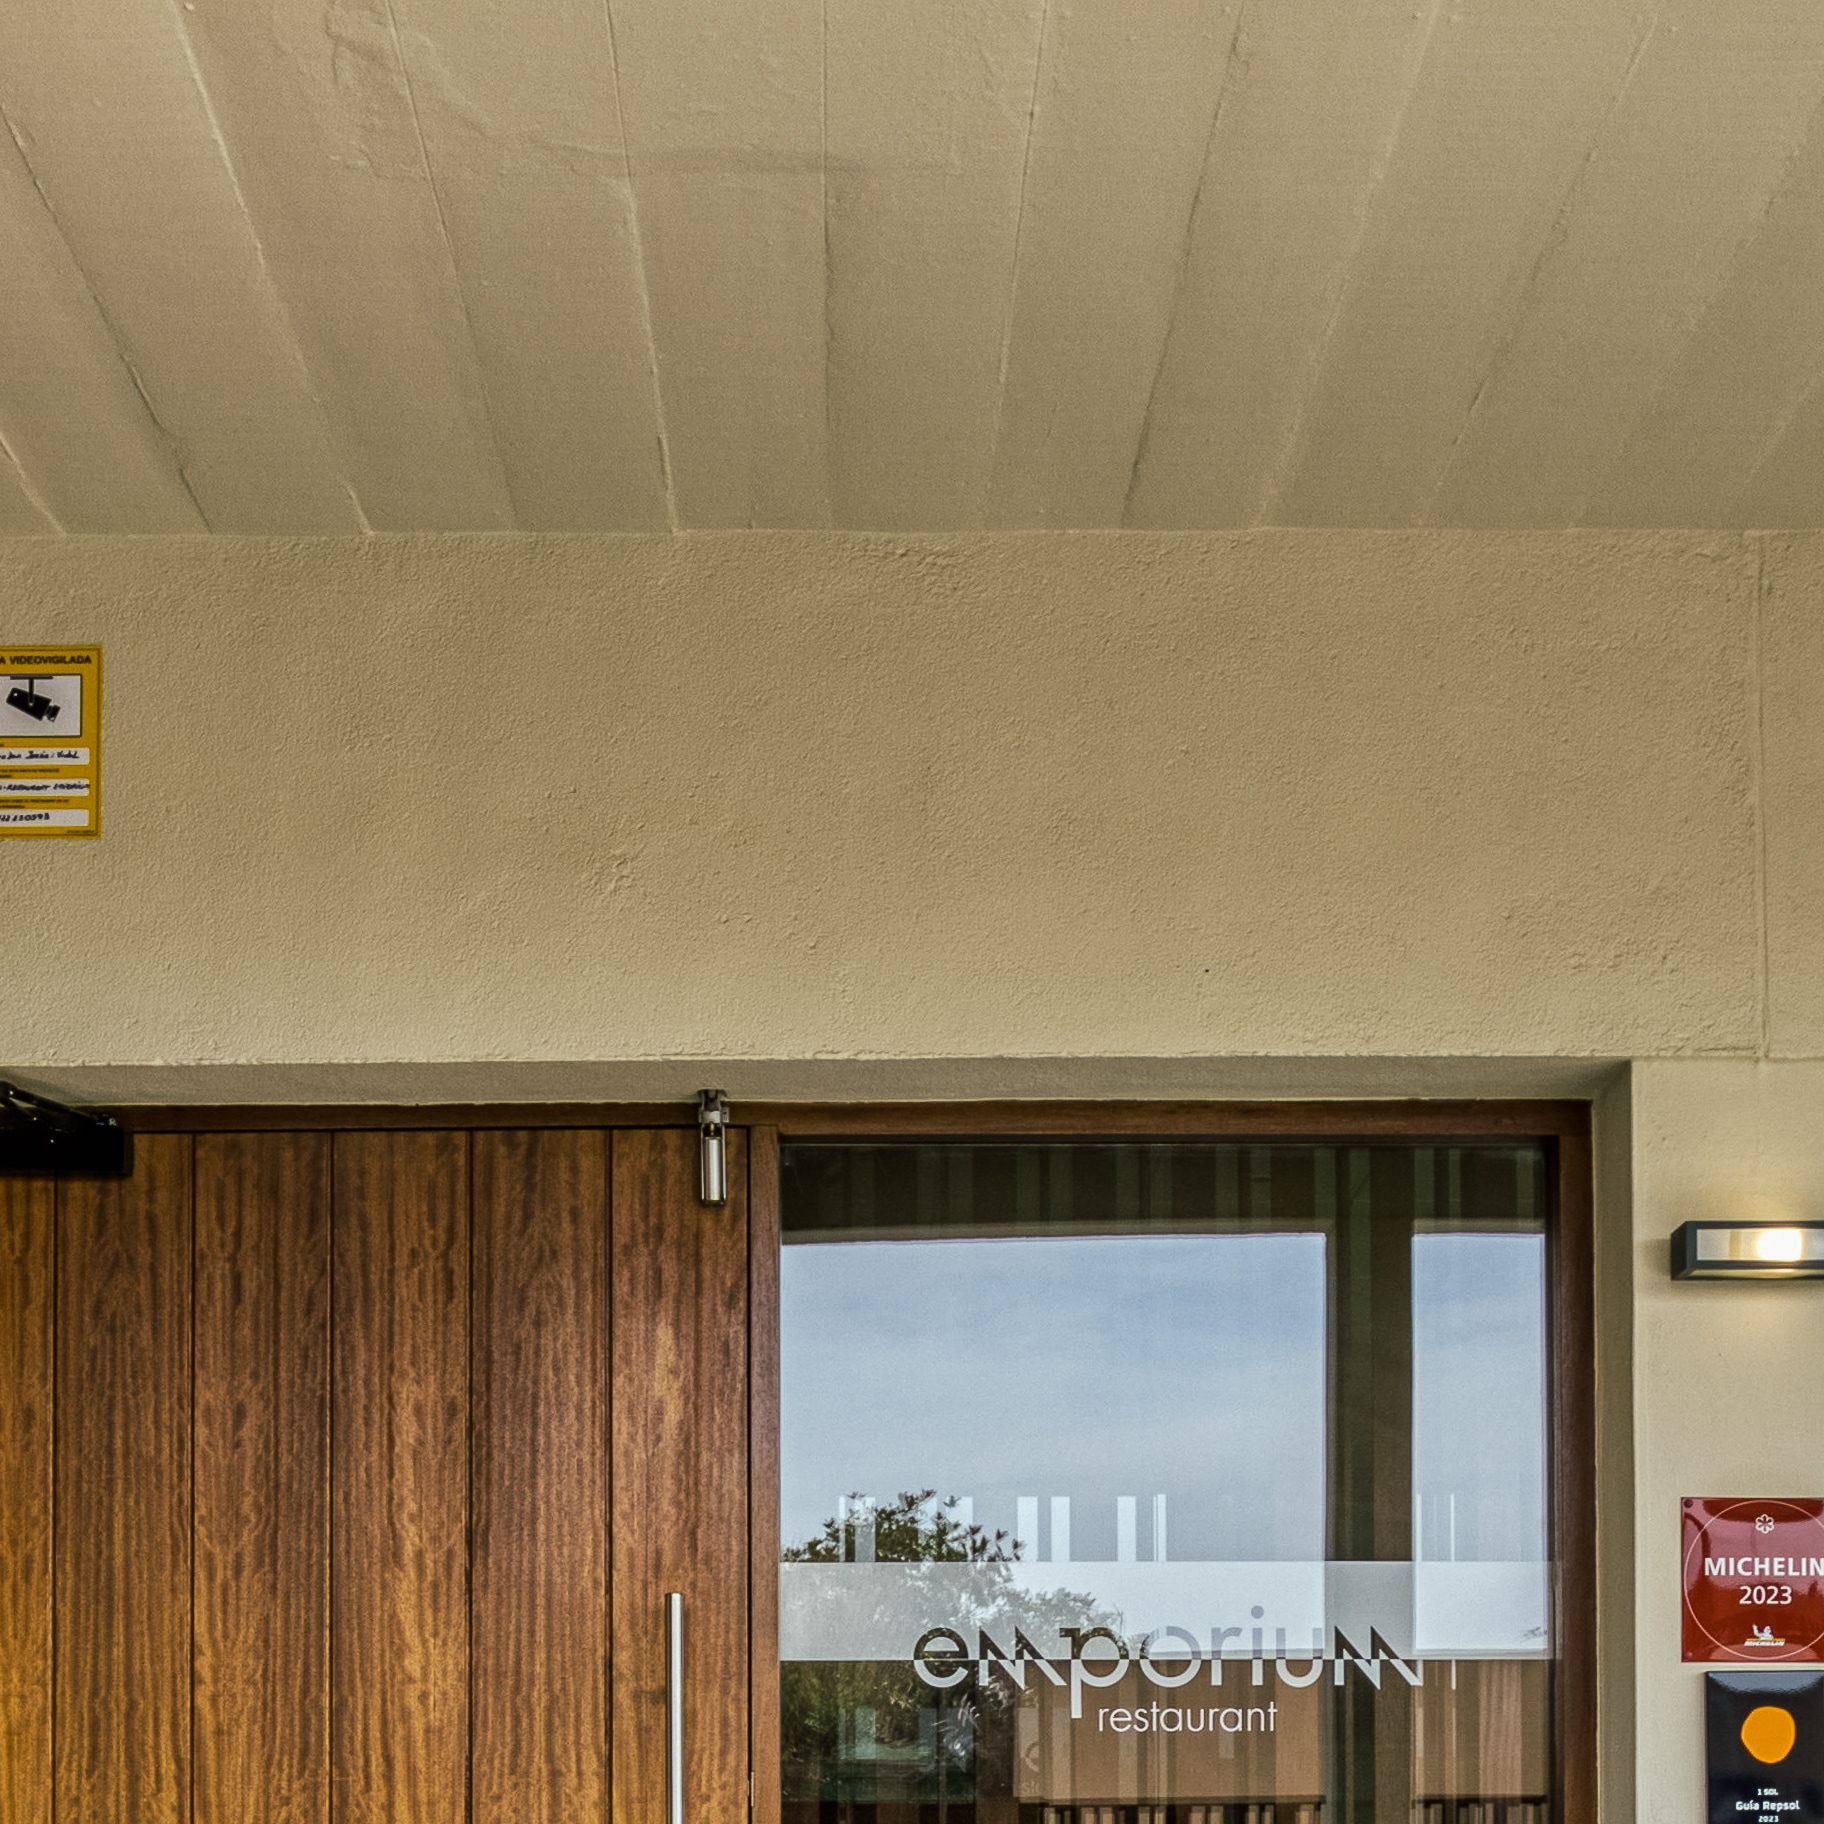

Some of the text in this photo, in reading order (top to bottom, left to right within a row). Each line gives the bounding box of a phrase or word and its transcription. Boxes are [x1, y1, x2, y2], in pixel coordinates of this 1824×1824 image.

[9, 655, 92, 665] VIDEOVIGILADA
[1739, 1586, 1793, 1605] 2023
[913, 1605, 1424, 1719] emporium
[1098, 1701, 1278, 1733] restaurant
[1735, 1800, 1801, 1812] Guía Repsol
[1758, 1815, 1779, 1823] 2023
